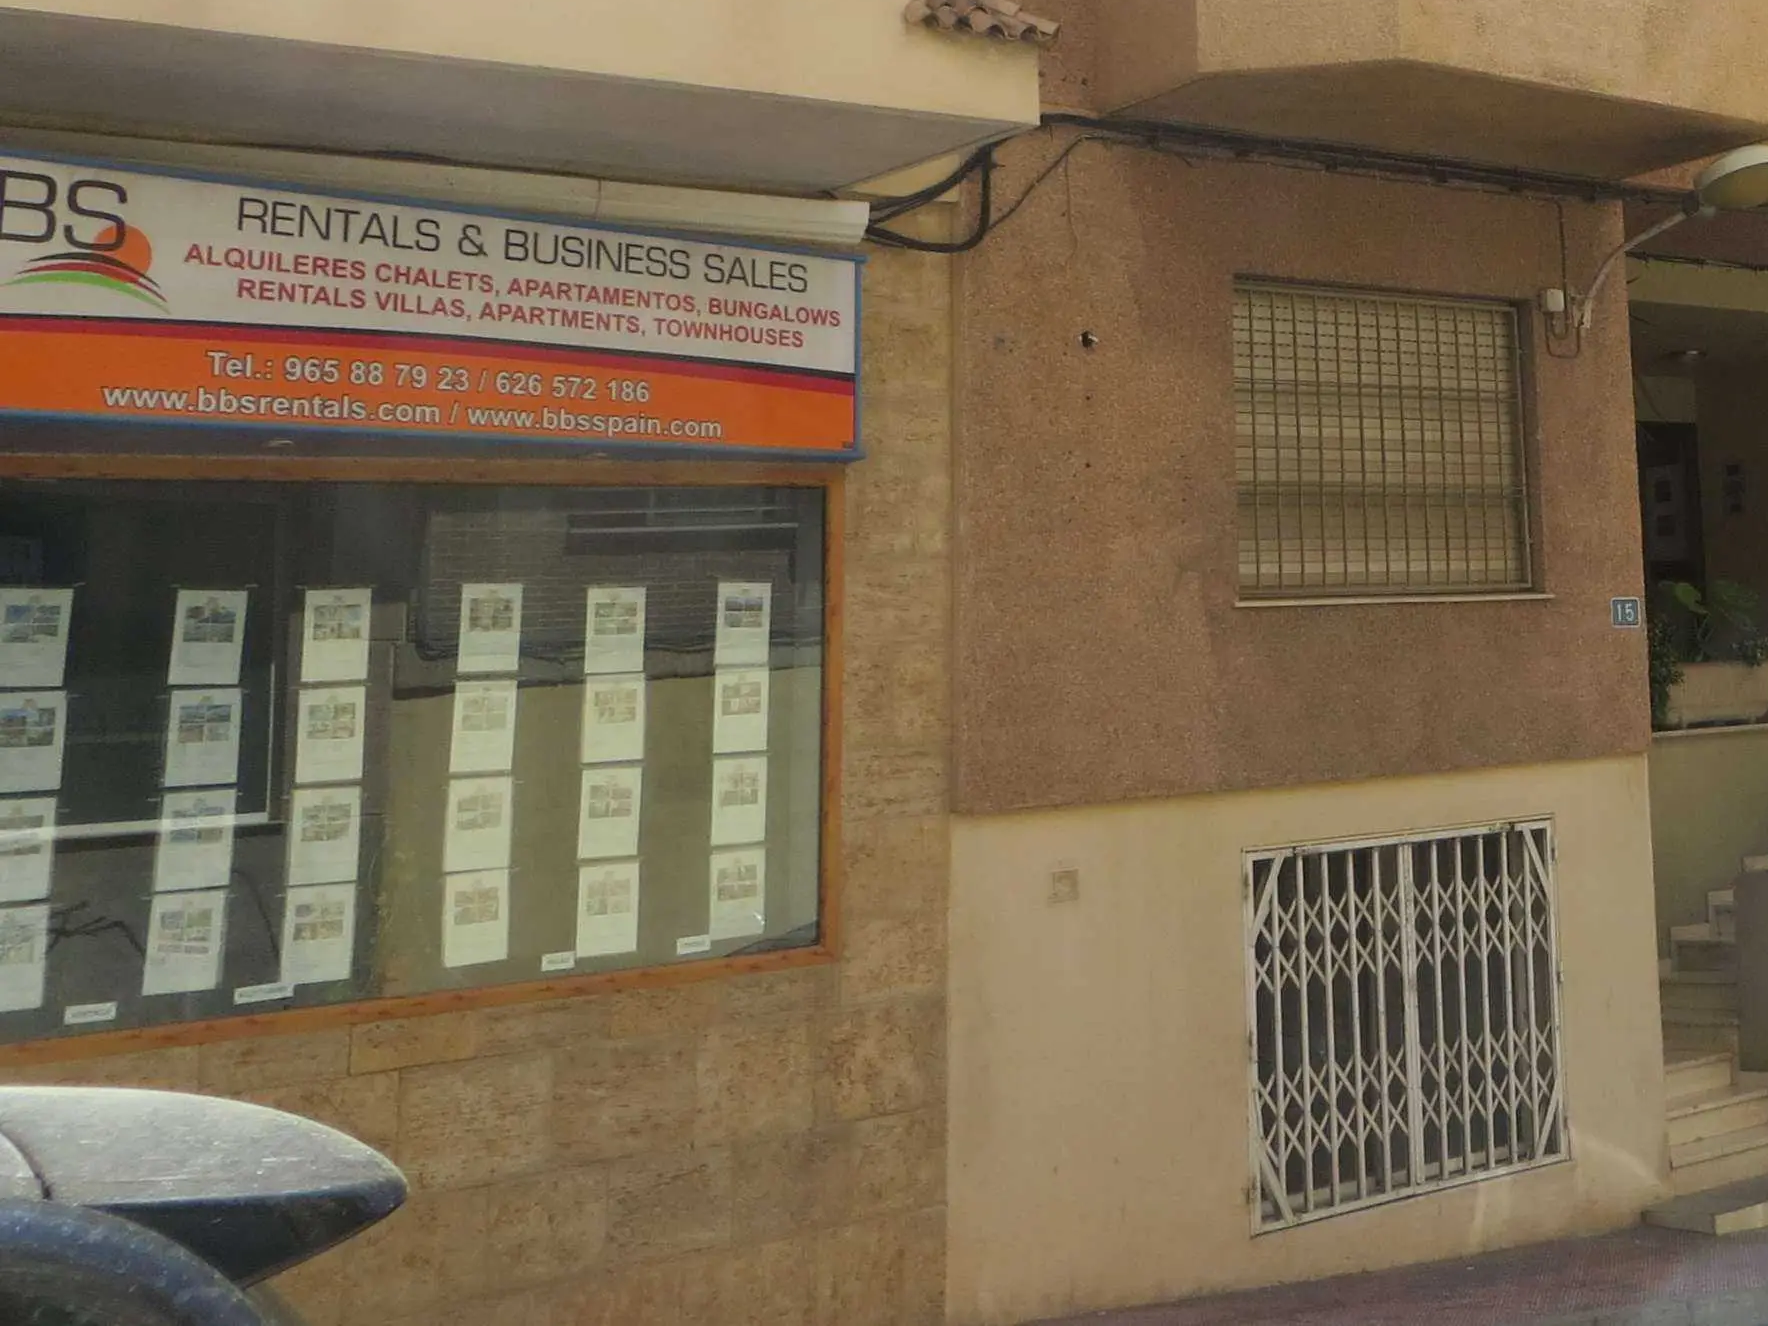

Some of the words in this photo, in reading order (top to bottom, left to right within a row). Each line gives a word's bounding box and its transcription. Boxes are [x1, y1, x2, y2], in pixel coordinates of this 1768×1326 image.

[238, 197, 441, 252] RENTALS
[458, 224, 488, 257] &
[504, 229, 690, 280] BUSINESS
[704, 253, 808, 294] SALES
[184, 243, 366, 280] ALQUILERES
[374, 263, 500, 297] CHALETS,
[507, 277, 701, 316] APARTAMENTOS,
[708, 298, 841, 327] BUNGALOWS
[237, 278, 366, 309] RENTALS
[375, 291, 471, 321] VILLAS,
[479, 302, 646, 336] APARTMENTS,
[654, 317, 804, 348] TOWNHOUSES
[207, 349, 274, 380] Tel.:
[284, 356, 340, 383] 965
[349, 360, 385, 386] 88
[395, 363, 428, 389] 79
[437, 366, 470, 392] 23
[477, 370, 487, 393] /
[495, 371, 542, 397] 626
[552, 375, 598, 401] 572
[607, 379, 650, 403] 186
[102, 385, 441, 425] www.bbsrentals.com
[449, 402, 459, 426] /
[466, 405, 723, 439] www.bbsspain.com
[1616, 603, 1635, 622] 15
